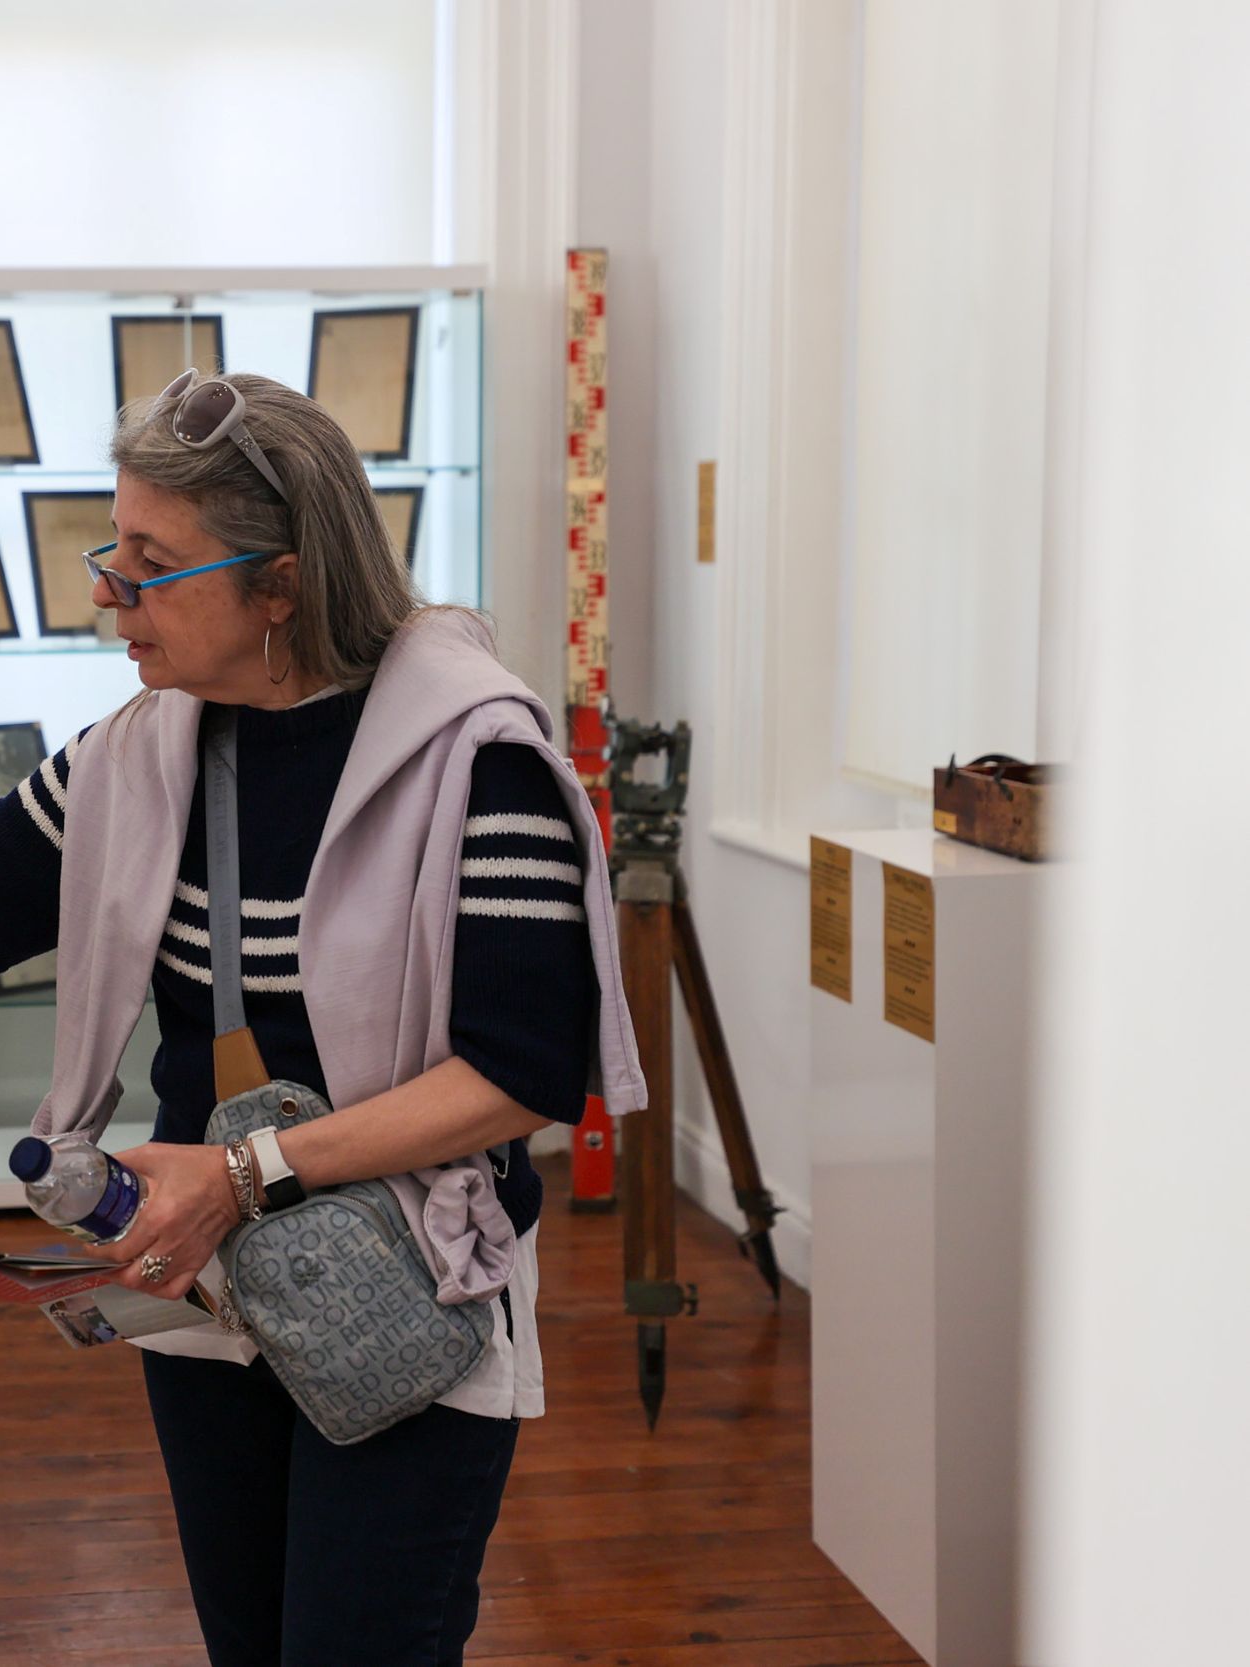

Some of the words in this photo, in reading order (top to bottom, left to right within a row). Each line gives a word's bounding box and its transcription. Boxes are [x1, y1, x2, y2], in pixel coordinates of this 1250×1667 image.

[259, 1279, 287, 1310] OF
[308, 1258, 405, 1338] COLORS
[304, 1338, 338, 1370] OF
[344, 1300, 434, 1372] UNITED
[345, 1354, 443, 1425] COLORS
